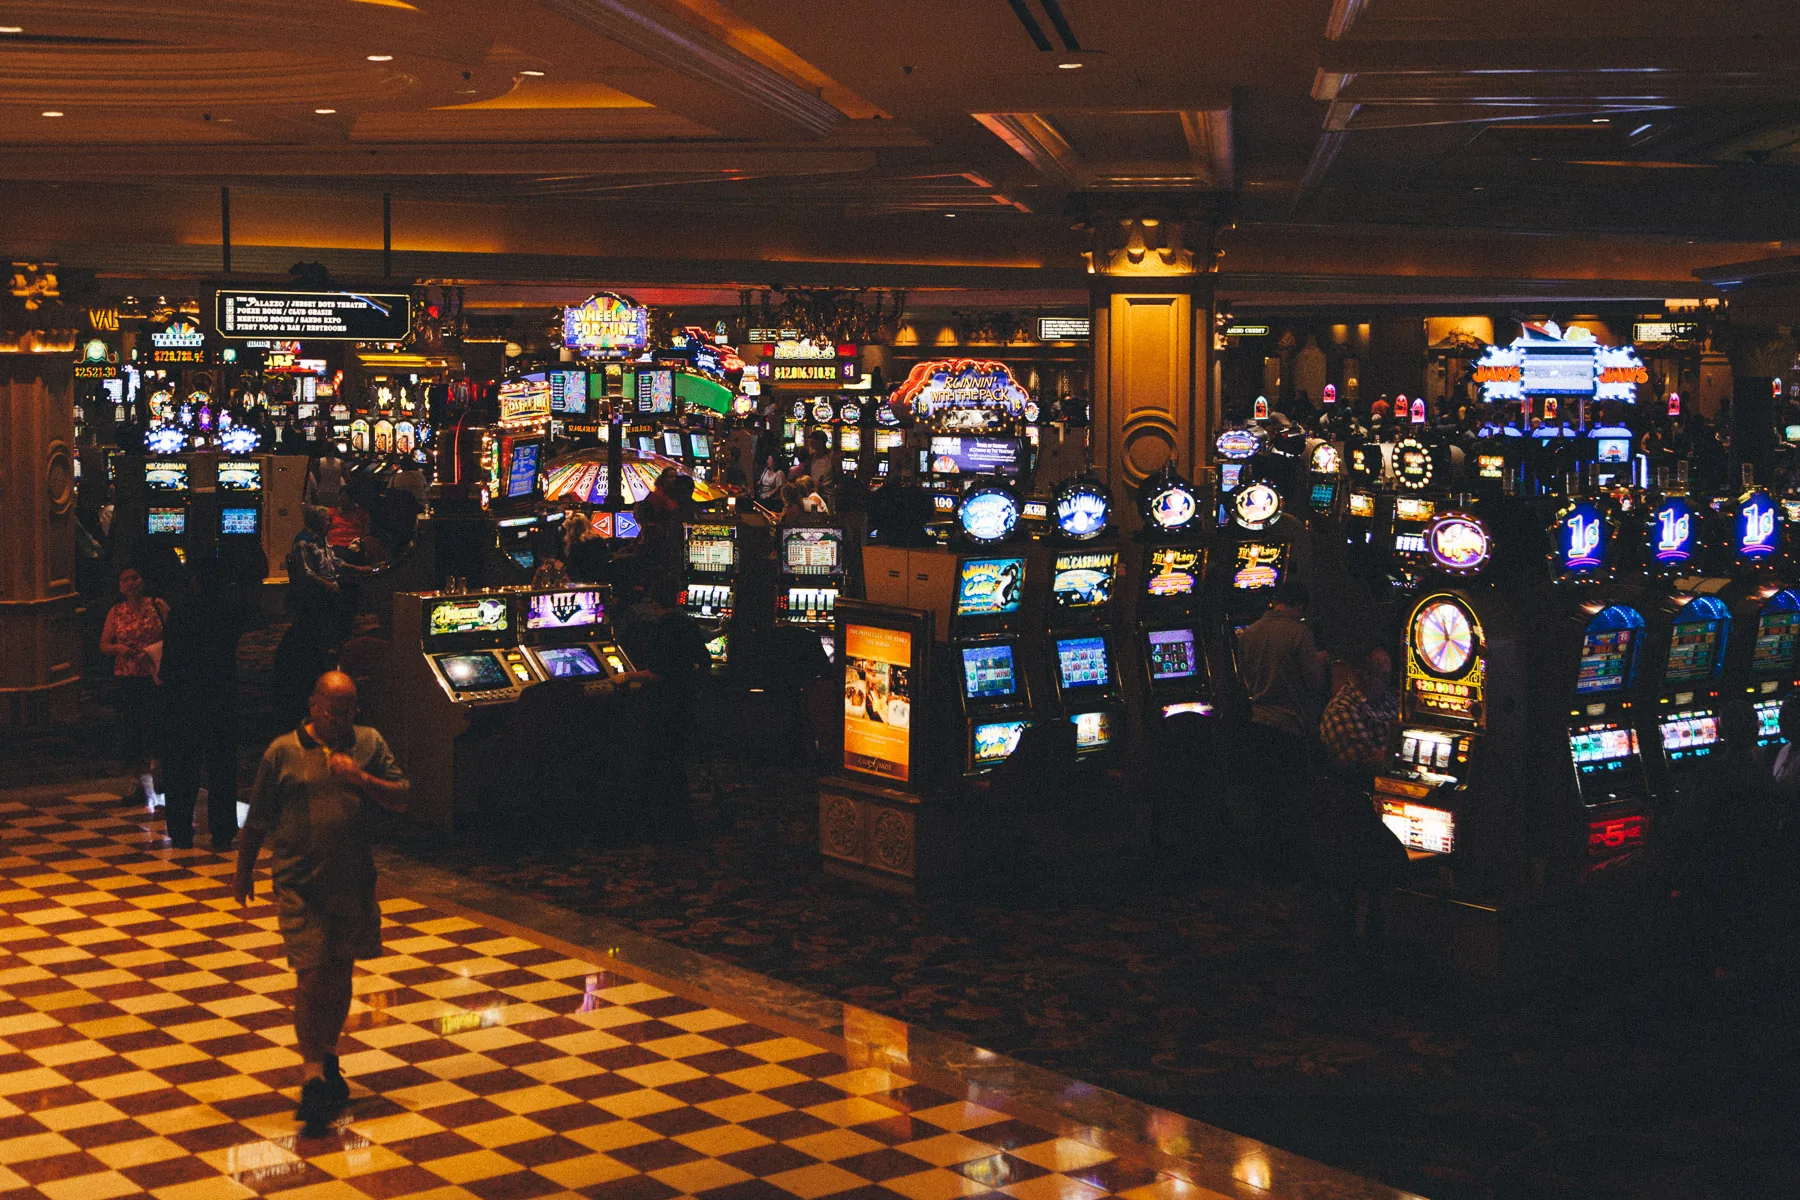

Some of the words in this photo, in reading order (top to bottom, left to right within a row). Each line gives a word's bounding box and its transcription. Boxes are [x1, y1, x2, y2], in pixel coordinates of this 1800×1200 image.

[246, 297, 284, 307] PALAZZO
[573, 309, 620, 321] WHEEL
[621, 309, 638, 321] OF
[574, 322, 637, 335] FORTUNE
[760, 364, 769, 377] $1
[844, 364, 854, 377] $1
[1472, 365, 1522, 383] JAWS
[1599, 366, 1649, 384] JAWS
[944, 376, 998, 389] RUNNIN'
[931, 391, 955, 402] WITH
[956, 391, 978, 401] THE
[979, 389, 1009, 401] PACK
[934, 497, 953, 508] 100
[1658, 508, 1690, 550] 1¢
[1742, 503, 1774, 545] 1¢
[1567, 514, 1600, 559] 1¢
[1071, 555, 1112, 568] CASHMAN
[1605, 823, 1626, 847] 5
